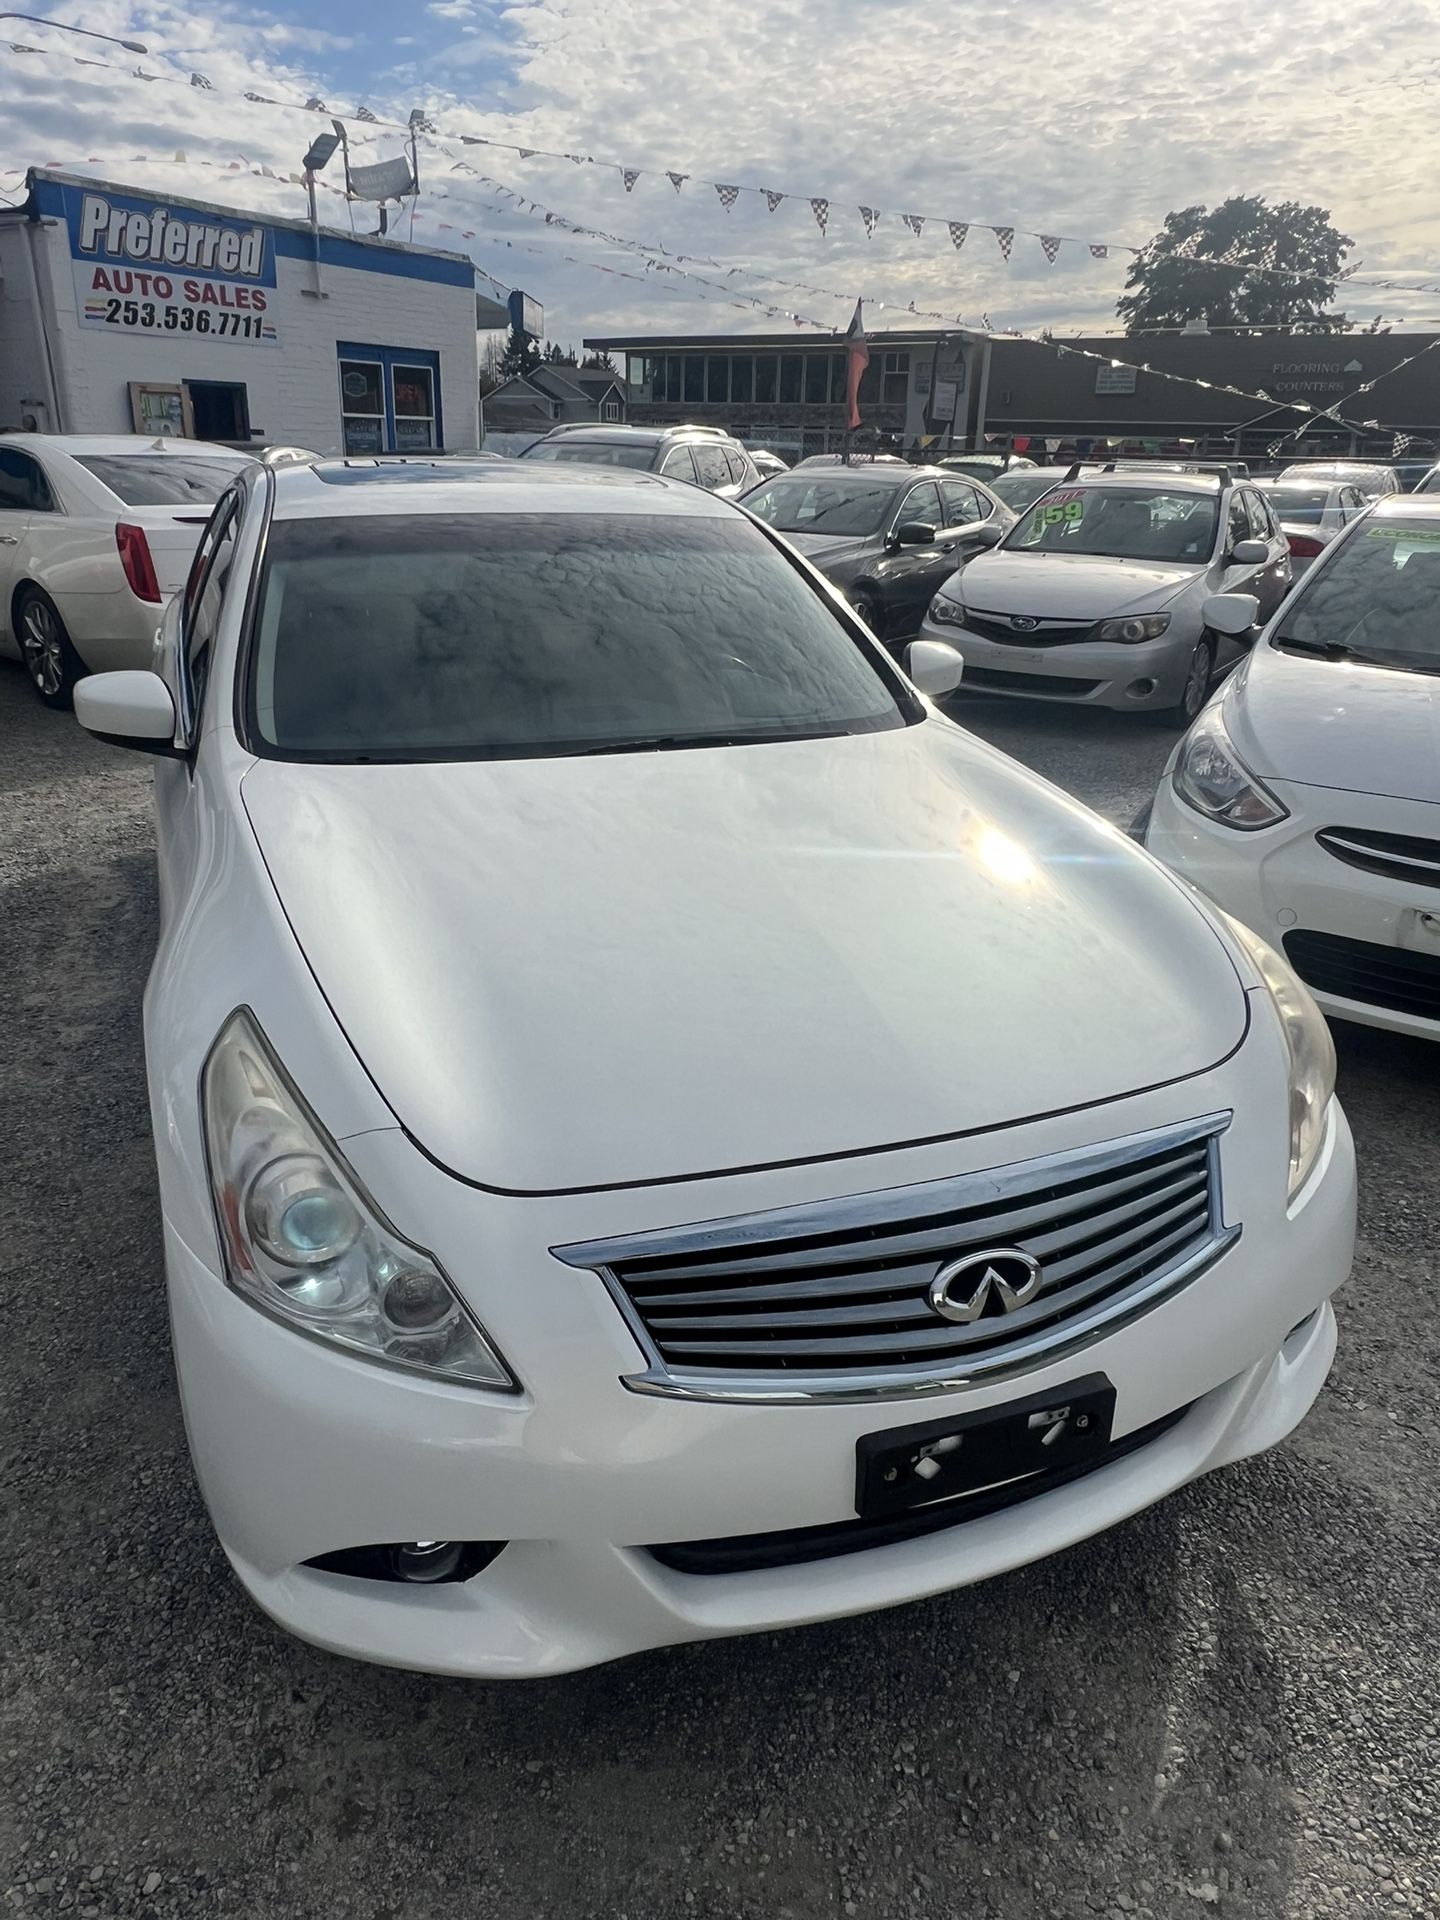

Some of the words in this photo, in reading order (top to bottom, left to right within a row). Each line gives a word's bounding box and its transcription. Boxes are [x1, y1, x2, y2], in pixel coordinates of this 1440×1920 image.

[80, 194, 265, 278] Preferred
[92, 267, 173, 299] AUTO
[184, 279, 267, 311] SALES
[105, 299, 263, 339] 253.536.7711
[1272, 363, 1340, 374] FLOORING
[1276, 381, 1344, 393] COUNTERS
